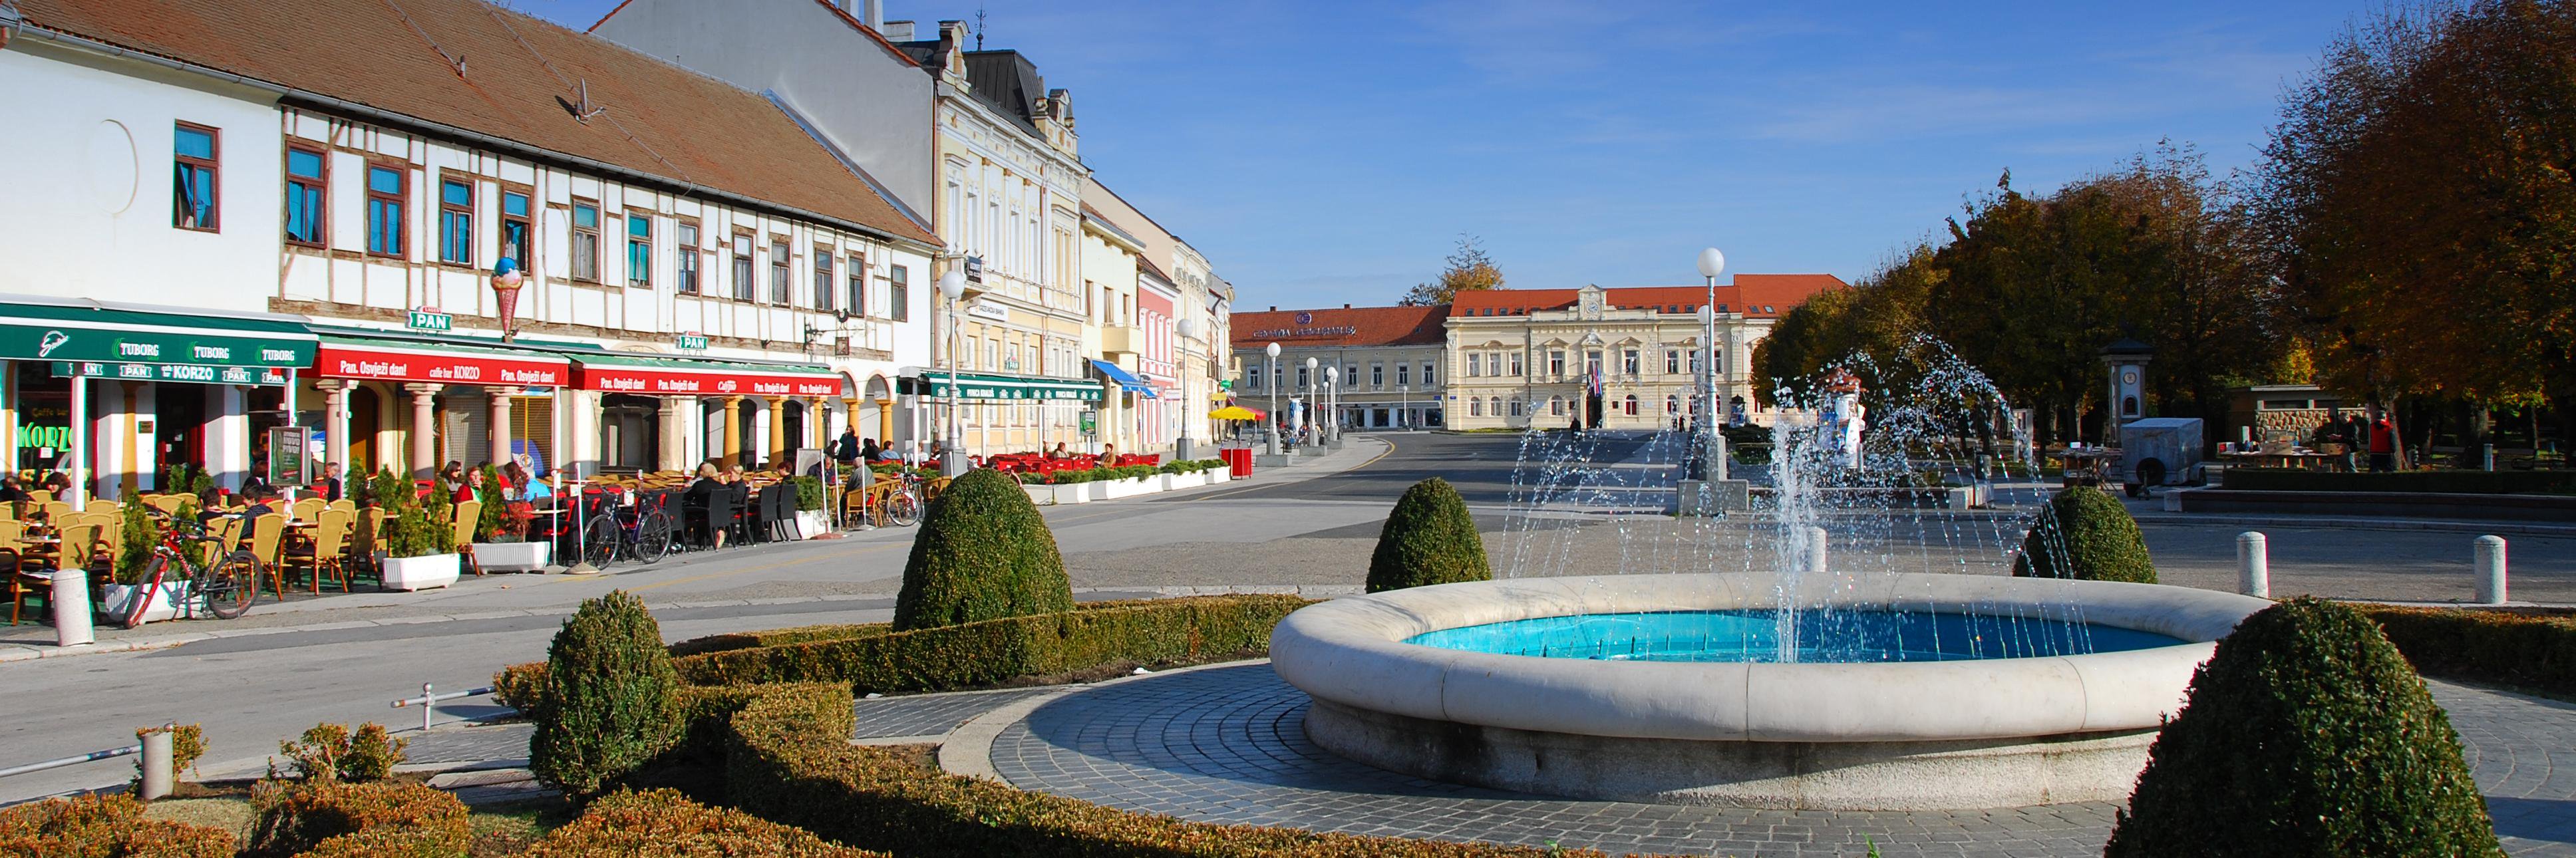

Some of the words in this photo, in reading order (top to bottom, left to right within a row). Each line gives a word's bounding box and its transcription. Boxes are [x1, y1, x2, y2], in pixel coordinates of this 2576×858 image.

[417, 314, 446, 329] PAN
[685, 337, 705, 349] PAN
[120, 343, 159, 357] TUBORG
[194, 346, 230, 359] TUBORG
[262, 349, 295, 361] TUBORG
[125, 367, 147, 376] PAN
[173, 365, 214, 380] KORZO
[340, 360, 359, 374] Pan.
[360, 361, 389, 377] Osvježi
[389, 363, 407, 376] dan!
[454, 365, 480, 380] KORZO
[501, 369, 516, 381] Pan.
[516, 369, 540, 384] Osvježi
[540, 371, 555, 382] dan!
[600, 377, 613, 388] Pan.
[633, 379, 645, 390] dan!
[658, 379, 669, 390] Pan.
[687, 380, 699, 391] dan!
[18, 422, 73, 452] KORZ
[283, 436, 300, 446] NOVO
[283, 445, 299, 454] PIVO!
